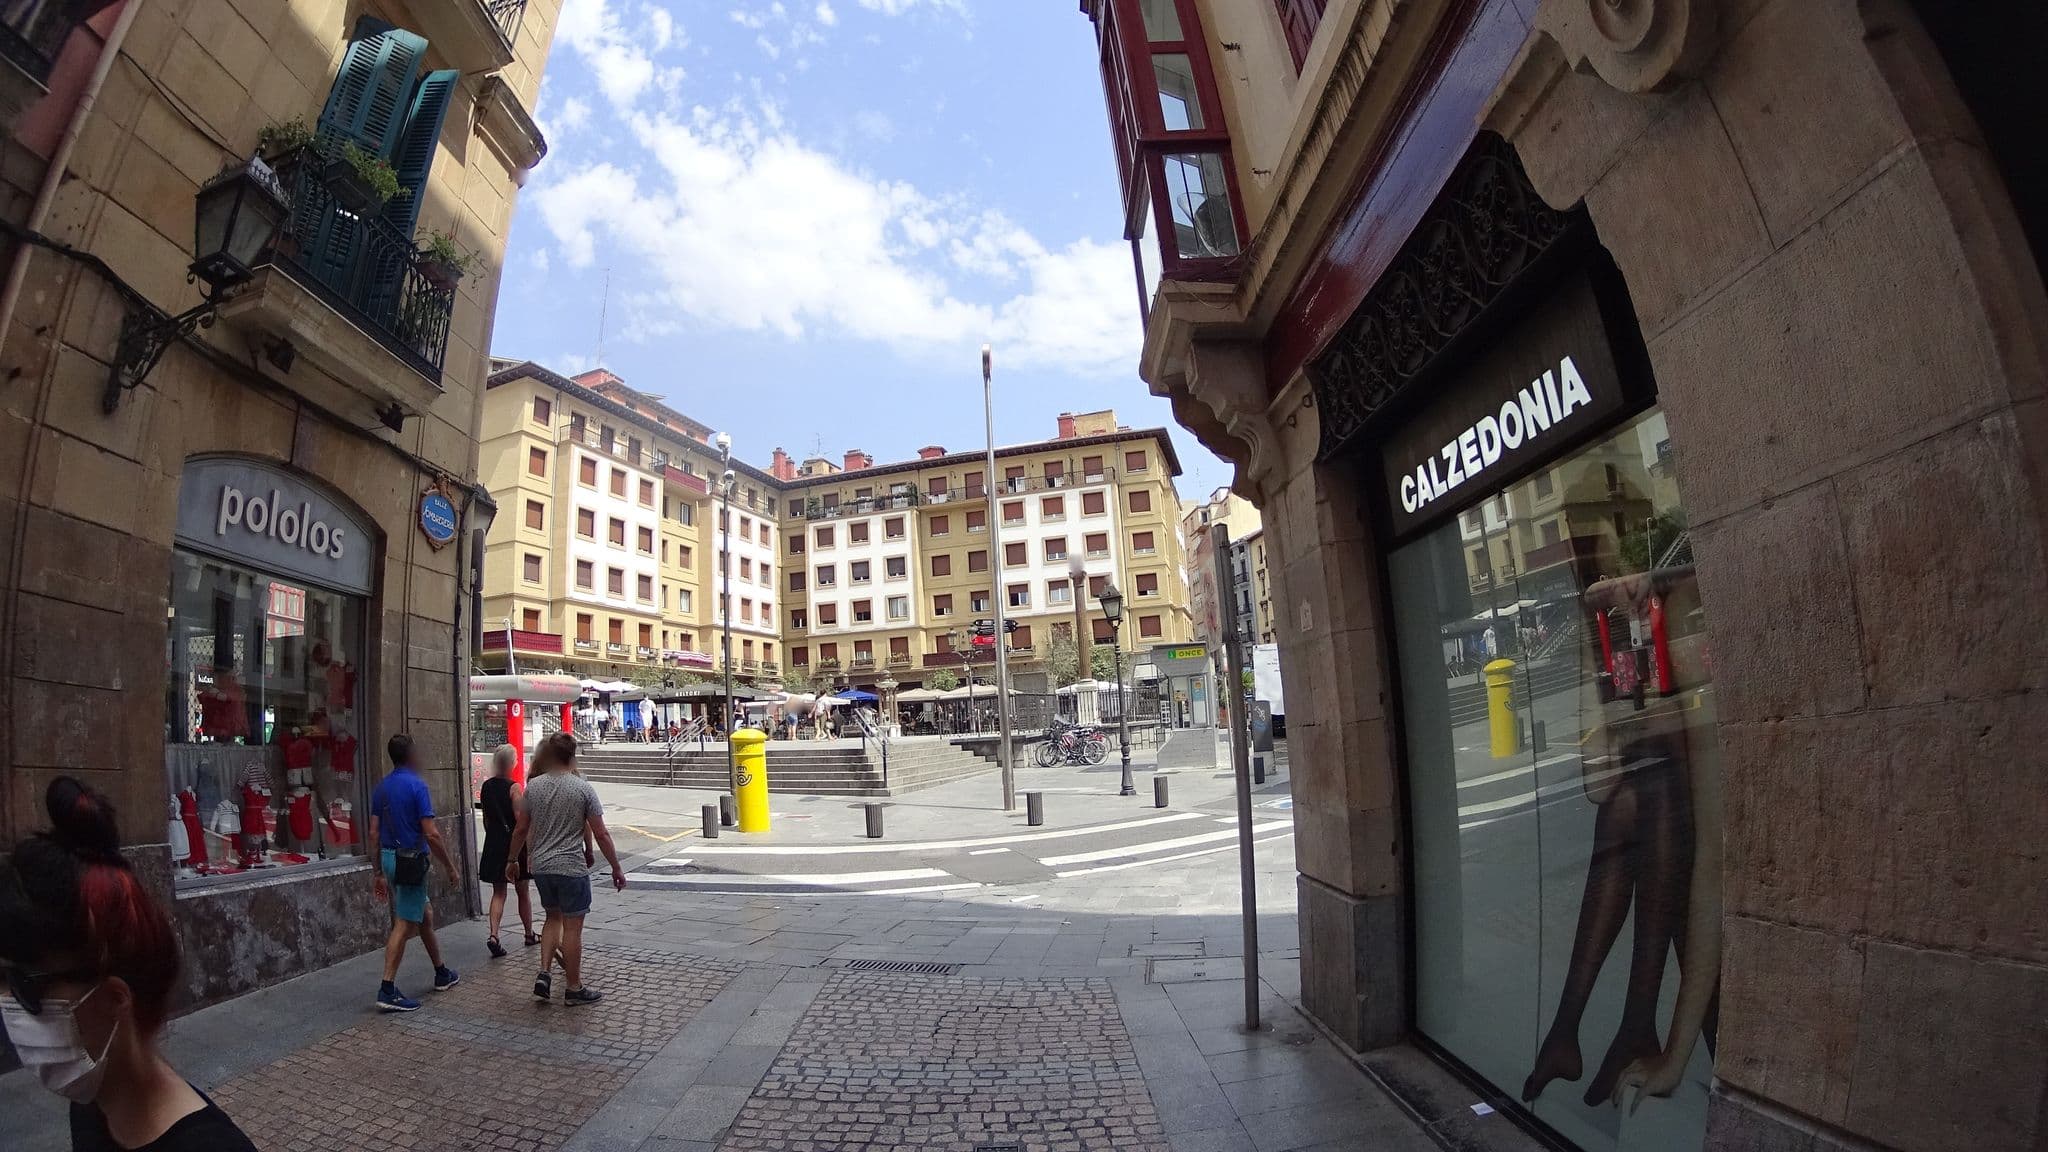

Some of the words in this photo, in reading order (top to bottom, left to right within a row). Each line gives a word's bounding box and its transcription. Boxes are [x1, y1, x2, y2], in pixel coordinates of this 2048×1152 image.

[1401, 356, 1592, 514] CALZEDONIA
[216, 485, 345, 559] pololos
[1178, 649, 1203, 658] ONCE
